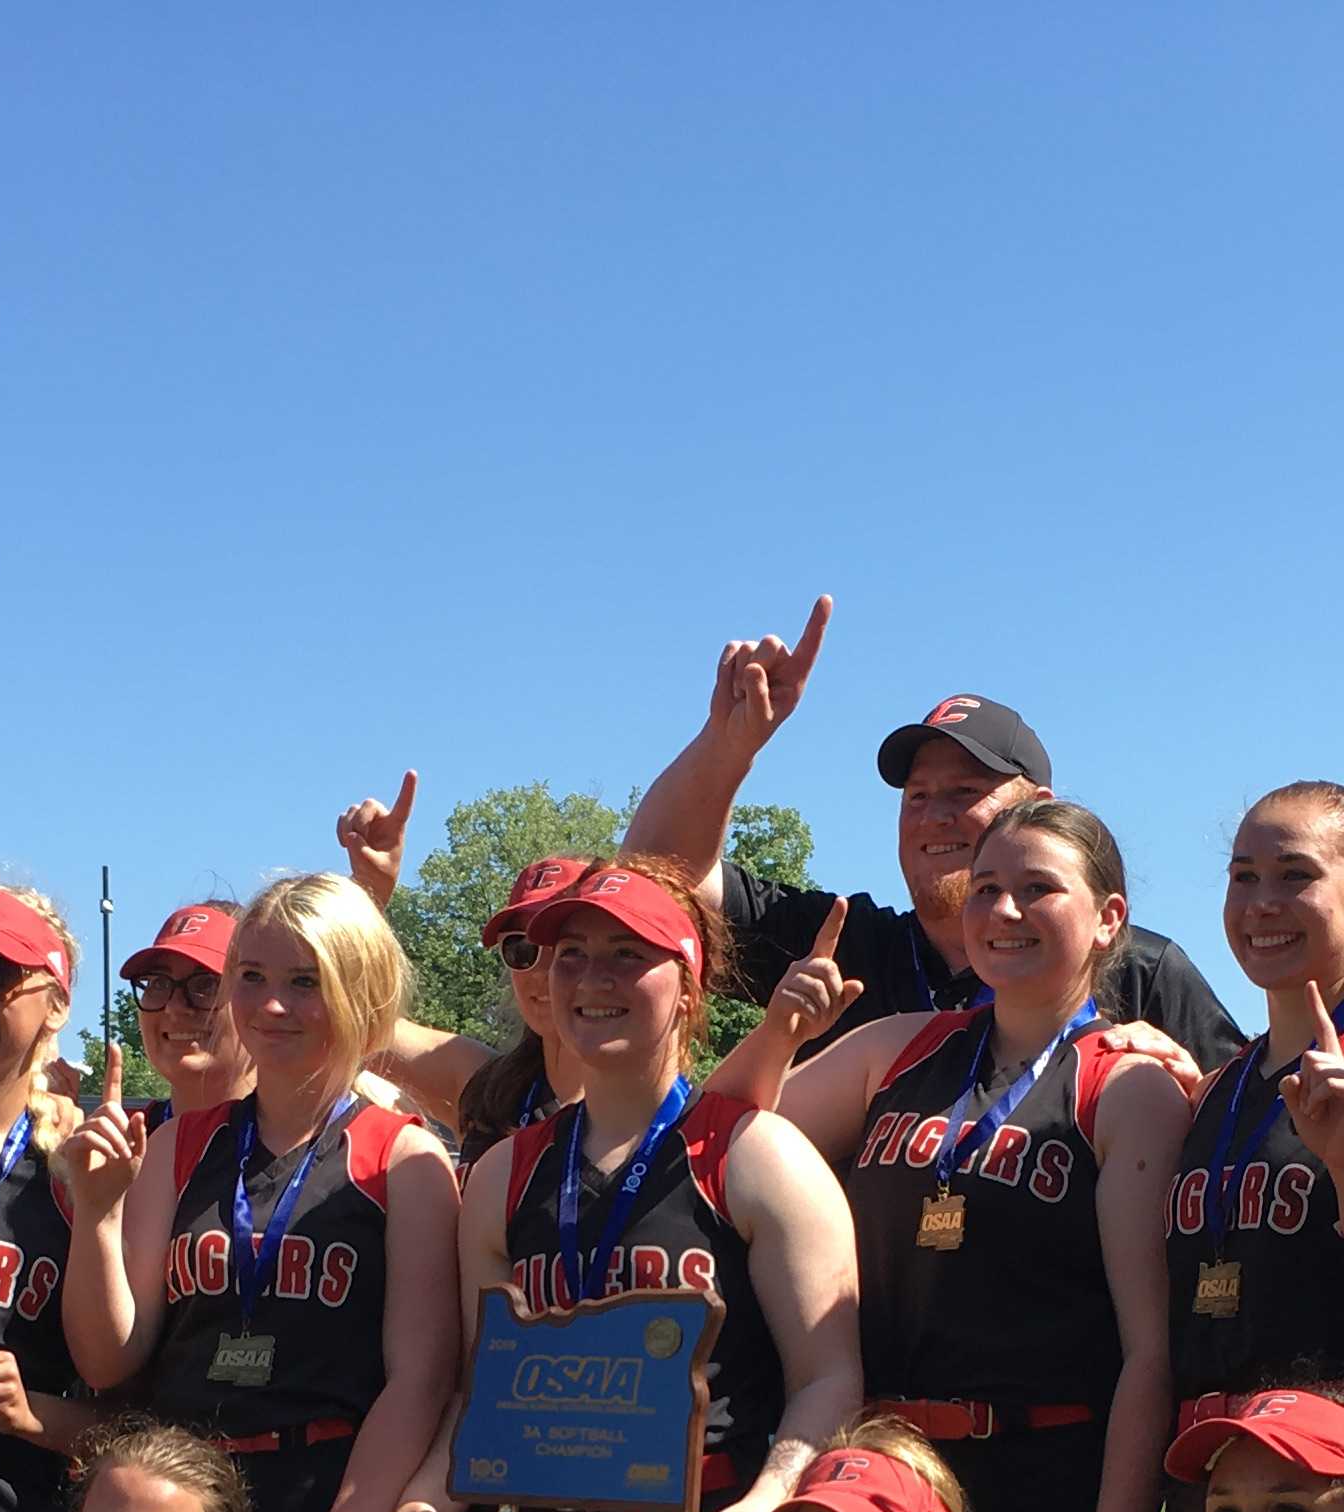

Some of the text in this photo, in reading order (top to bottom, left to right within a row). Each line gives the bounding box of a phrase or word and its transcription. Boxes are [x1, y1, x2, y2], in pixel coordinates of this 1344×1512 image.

[619, 1159, 650, 1197] 100
[921, 1212, 962, 1231] OSAA
[166, 1229, 358, 1308] IGRS
[1198, 1279, 1239, 1298] OSAA
[216, 1349, 273, 1368] OSAA
[512, 1354, 644, 1406] OSAA
[548, 1427, 625, 1443] SOFTBALL
